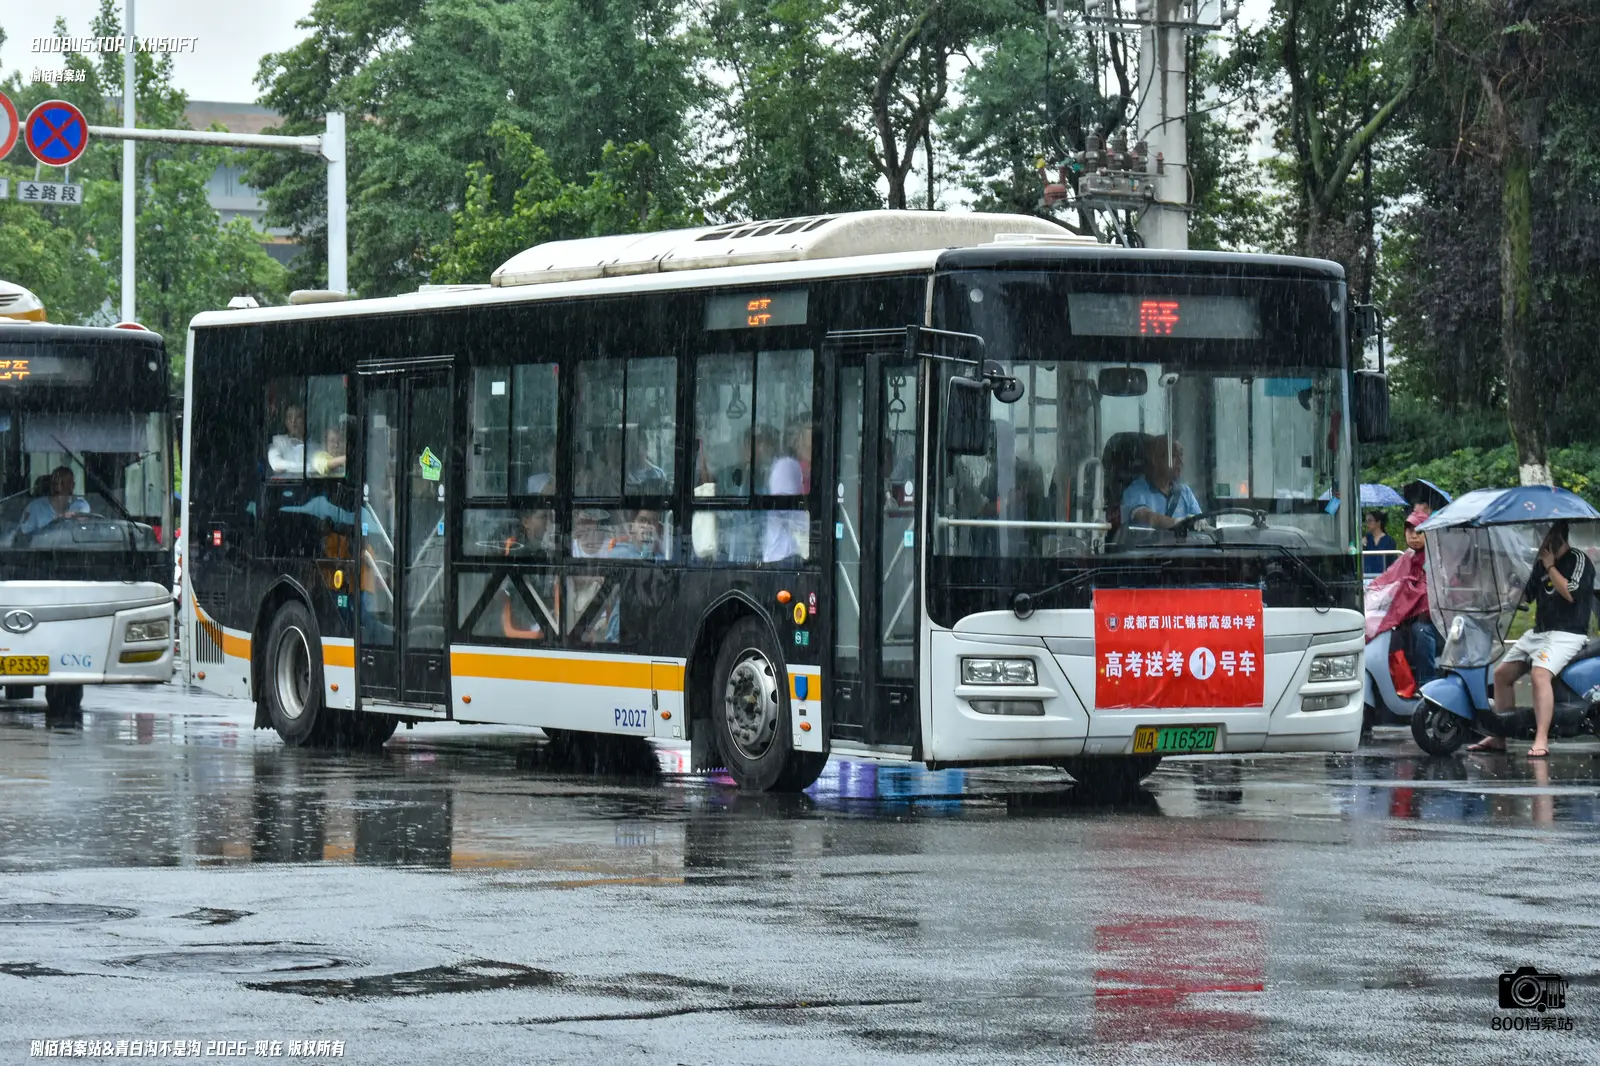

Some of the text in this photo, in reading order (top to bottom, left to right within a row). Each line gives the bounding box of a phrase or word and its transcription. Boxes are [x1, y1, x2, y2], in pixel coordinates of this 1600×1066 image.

[24, 183, 76, 202] 全路段
[1123, 615, 1256, 630] 成都西川汇锦都高级中学
[61, 654, 92, 667] CNG
[1105, 650, 1184, 678] 高考送考
[614, 708, 647, 728] P2027
